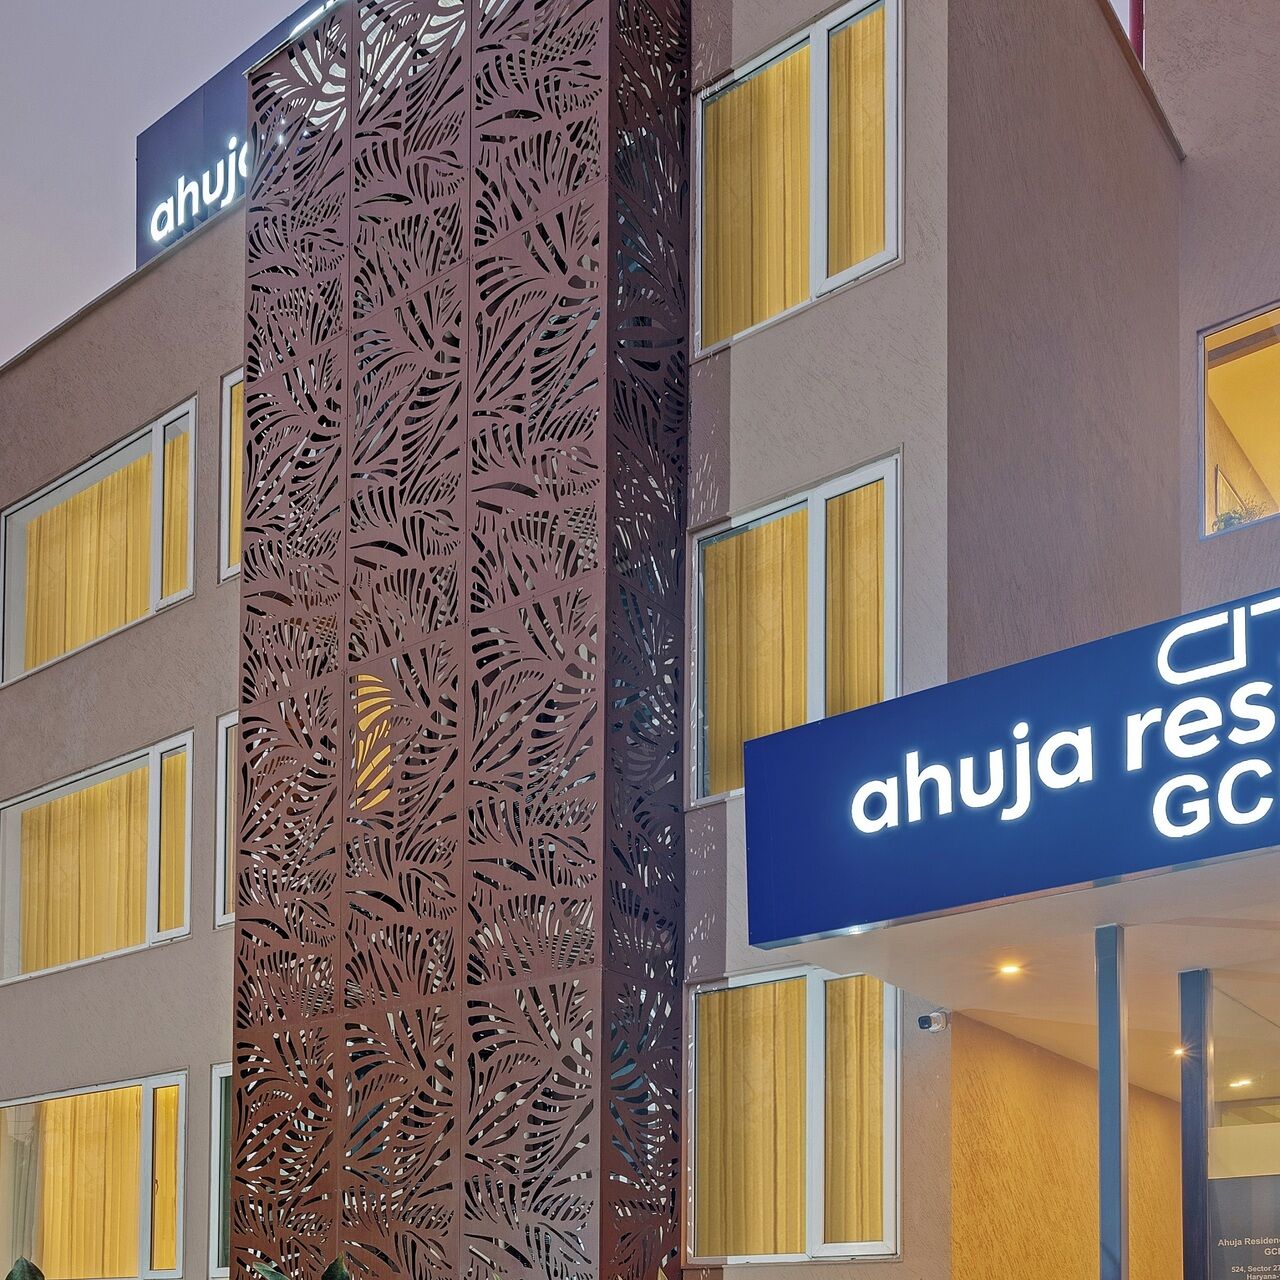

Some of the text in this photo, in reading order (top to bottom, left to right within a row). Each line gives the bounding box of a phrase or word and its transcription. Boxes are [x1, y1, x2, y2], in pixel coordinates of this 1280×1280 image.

[850, 720, 1094, 834] ahuja
[1218, 1239, 1242, 1248] Ahuja
[1247, 1265, 1271, 1273] Sector
